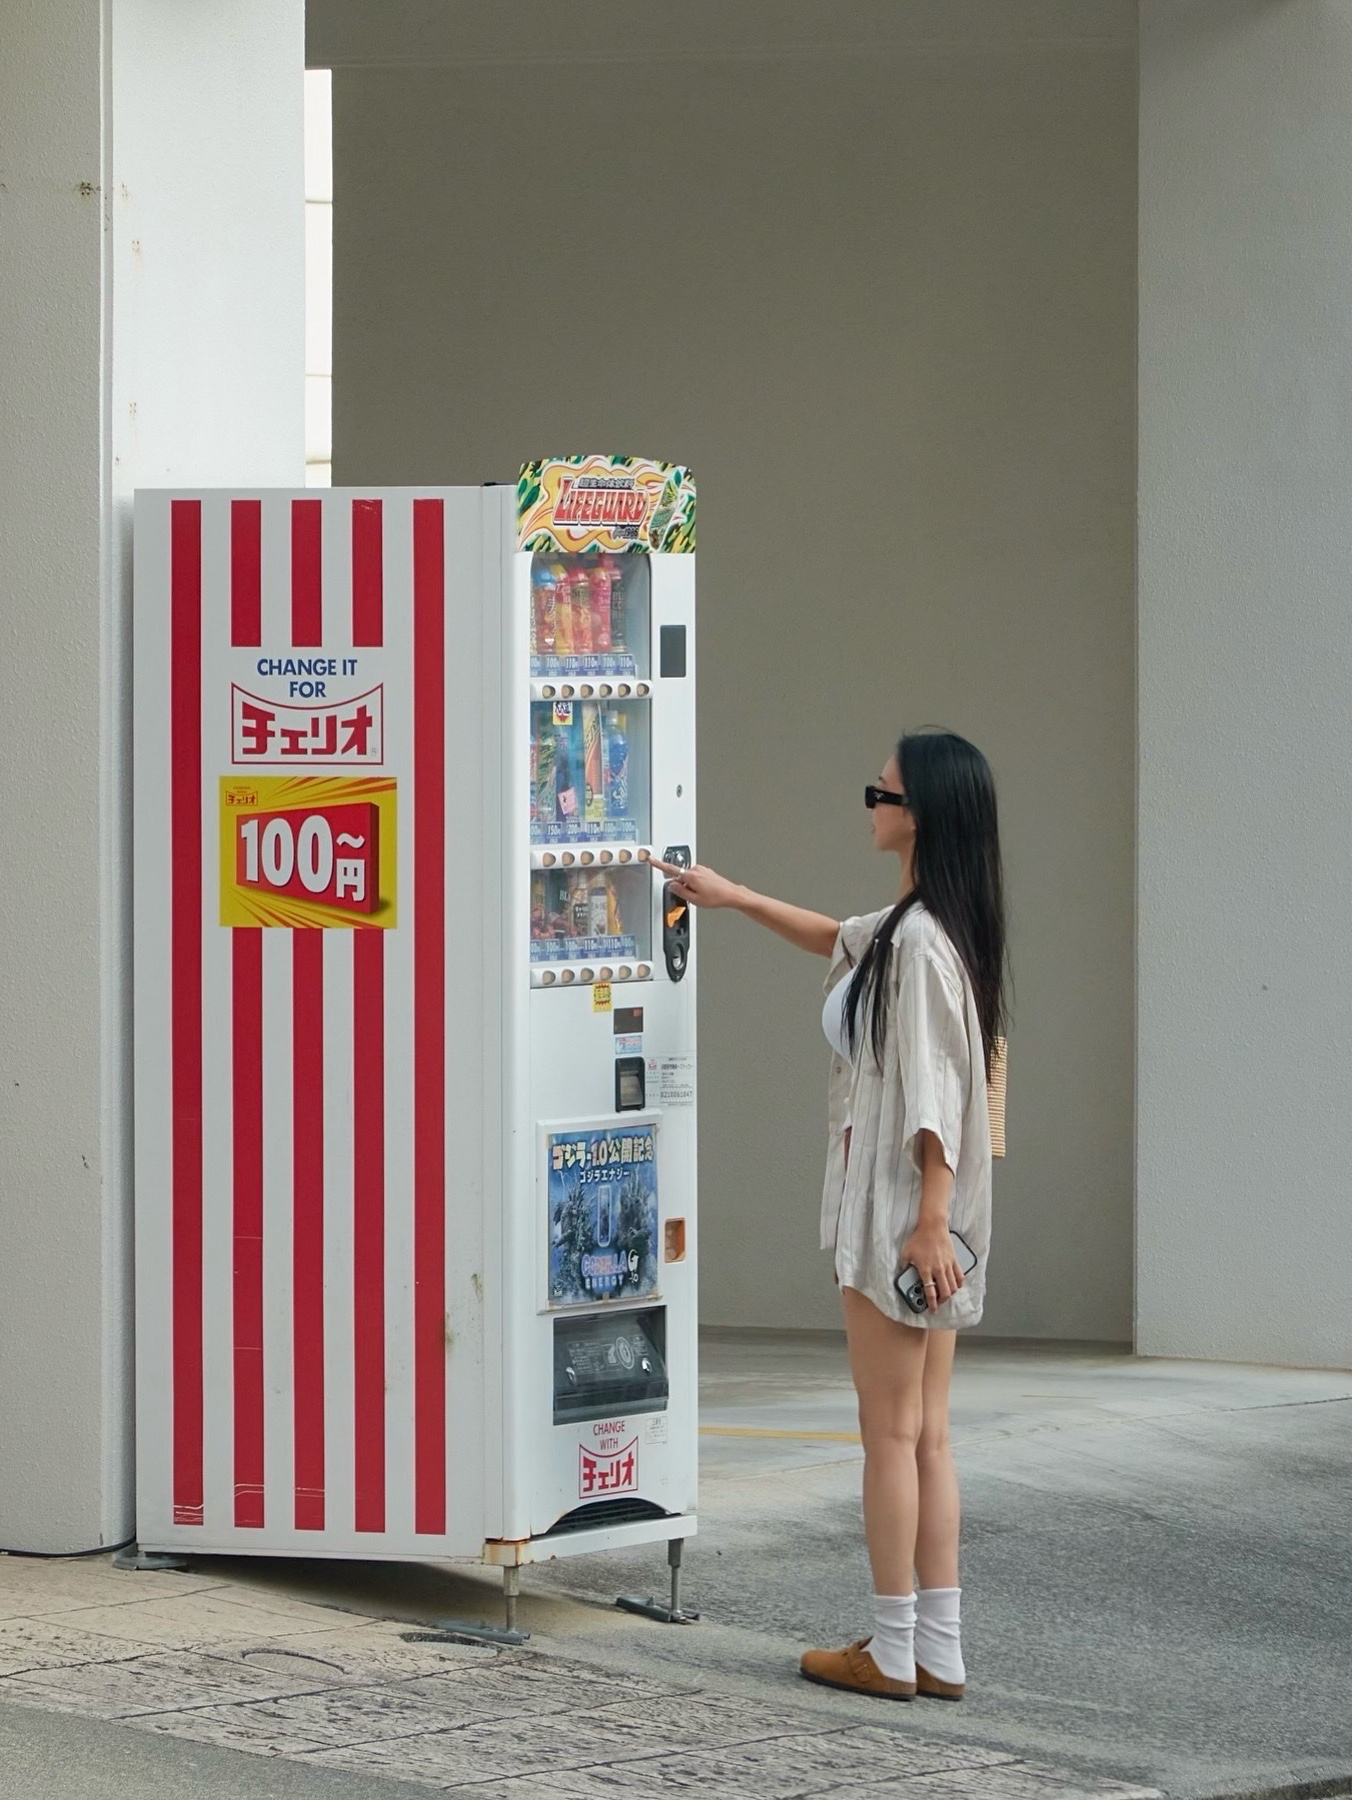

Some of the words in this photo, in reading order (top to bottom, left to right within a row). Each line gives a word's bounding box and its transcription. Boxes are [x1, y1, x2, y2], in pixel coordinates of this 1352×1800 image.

[553, 476, 648, 526] LIFEGUARD
[257, 658, 337, 677] CHANGE
[343, 659, 358, 676] IT
[289, 681, 326, 698] FOR
[242, 701, 373, 755] チェリオ
[553, 1135, 655, 1170] ゴジラ-1.0公開記念
[580, 1167, 630, 1183] ゴジラエナジー
[593, 1420, 625, 1436] CHANGE
[600, 1438, 619, 1450] WITH
[583, 1451, 634, 1492] チェリオ
